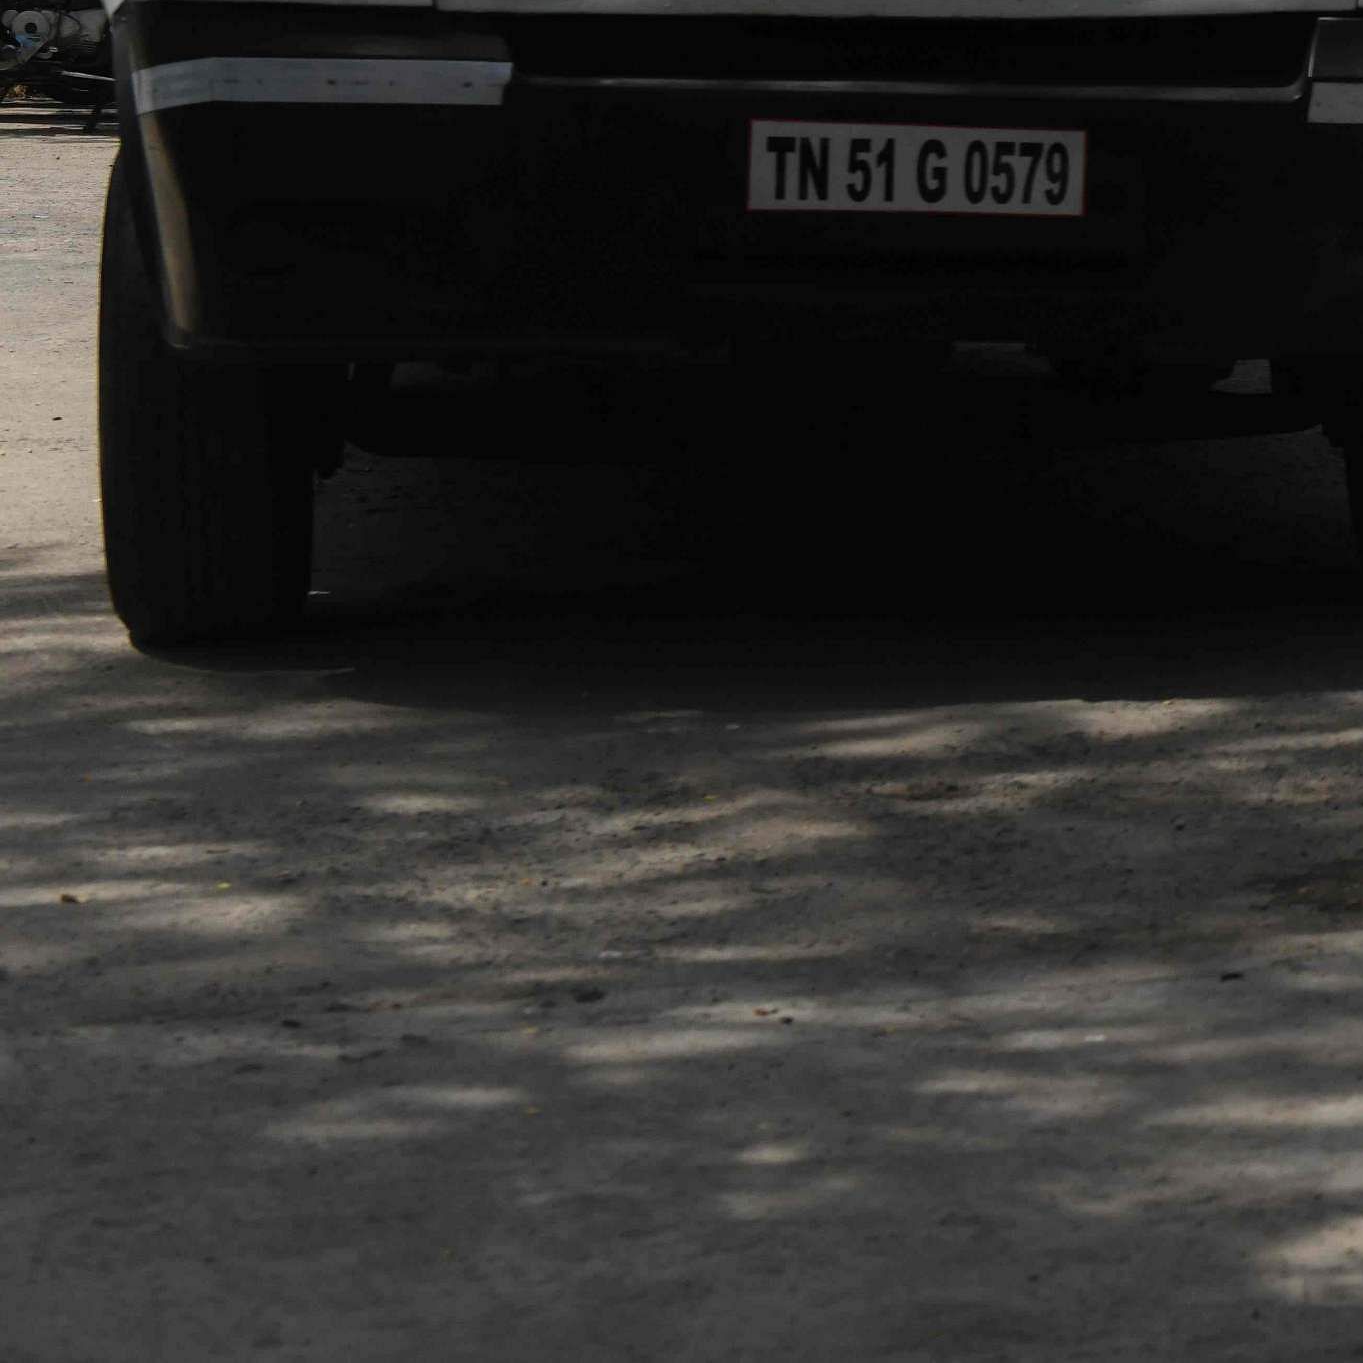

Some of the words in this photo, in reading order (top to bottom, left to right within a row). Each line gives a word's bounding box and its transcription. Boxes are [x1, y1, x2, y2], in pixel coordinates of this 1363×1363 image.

[766, 136, 831, 201] TN
[846, 138, 895, 203] 51
[916, 139, 948, 203] G
[964, 140, 1070, 206] 0579
